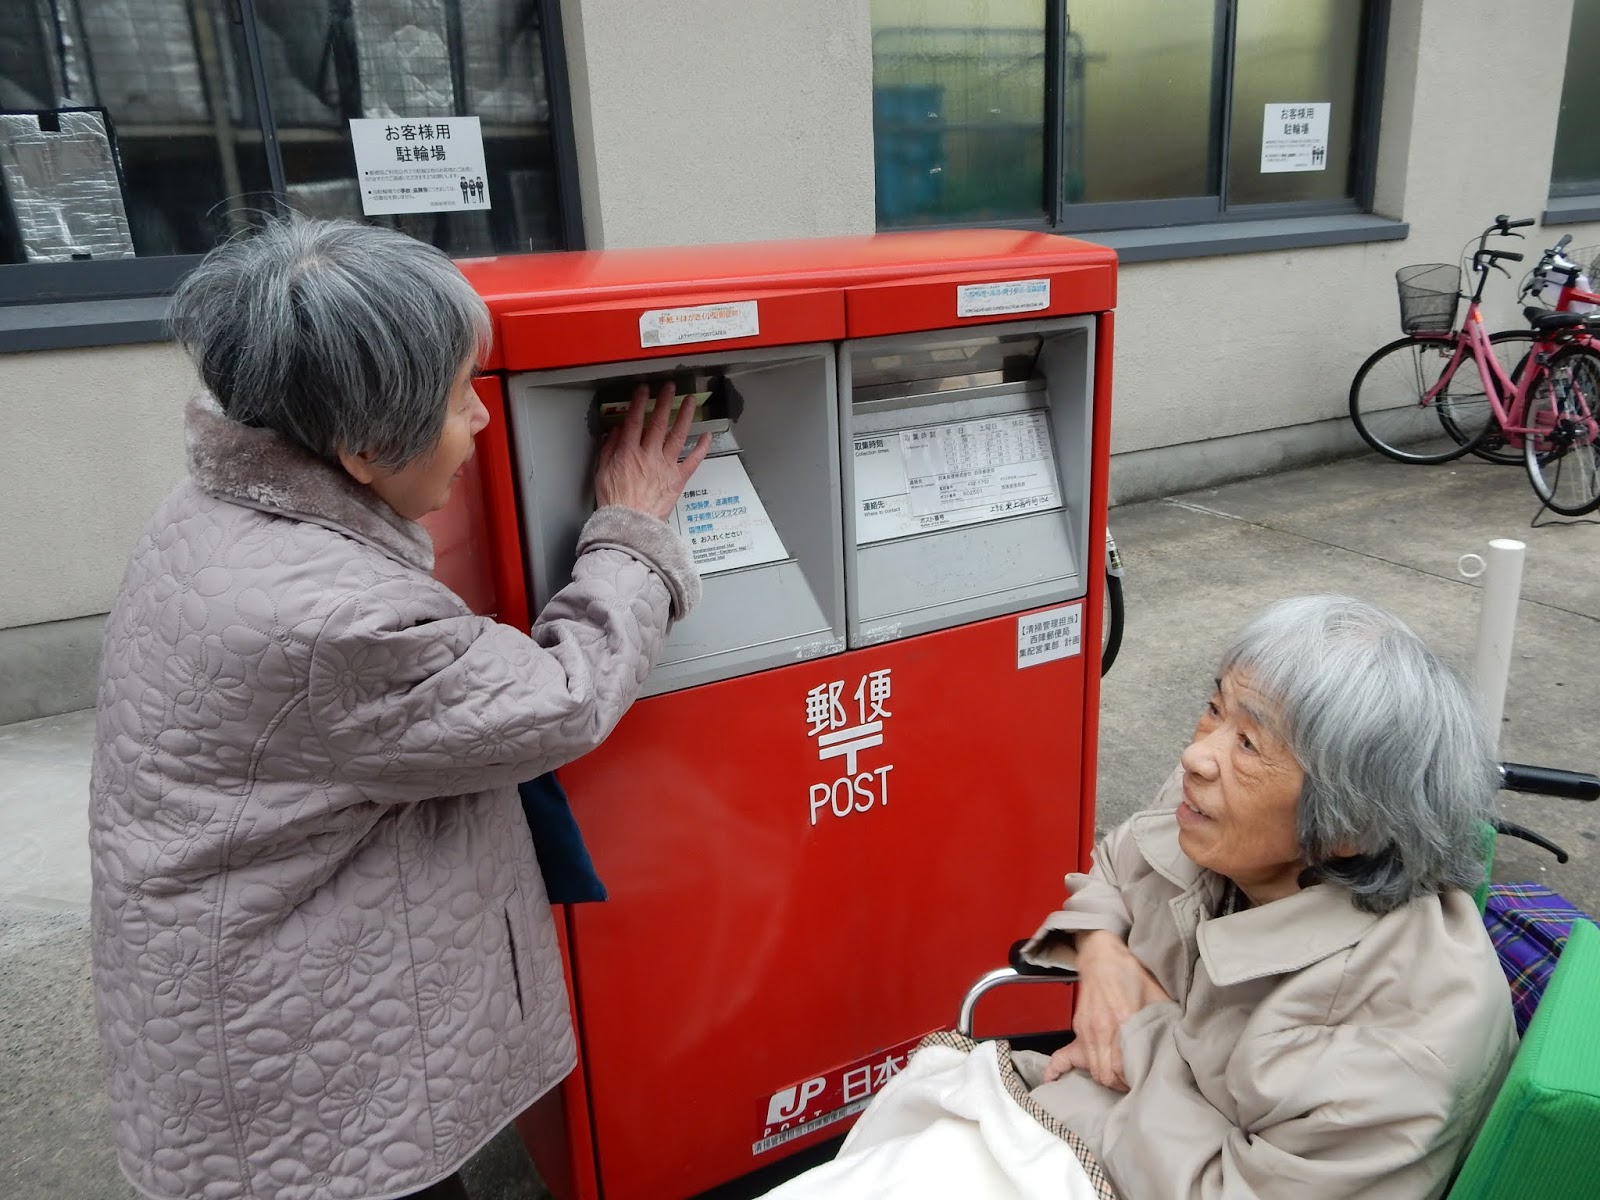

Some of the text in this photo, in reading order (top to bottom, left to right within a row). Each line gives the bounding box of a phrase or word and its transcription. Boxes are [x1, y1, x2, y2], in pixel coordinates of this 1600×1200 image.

[1281, 108, 1314, 120] お客様用
[385, 123, 451, 141] お客様用
[1284, 123, 1309, 135] 駐輪場
[395, 144, 446, 162] 駐輪場
[854, 439, 884, 451] 取集時刻
[855, 448, 877, 457] Collection
[683, 489, 708, 499] 右側には
[863, 500, 885, 511] 連絡先
[700, 530, 743, 544] お入れください
[1022, 614, 1077, 635] 【清掃管理担当】
[1030, 626, 1070, 645] 西陣郵便局
[1019, 635, 1080, 658] 集配営業部 計画
[806, 668, 892, 737] 郵便
[809, 764, 894, 826] POST
[843, 1050, 917, 1103] 日本
